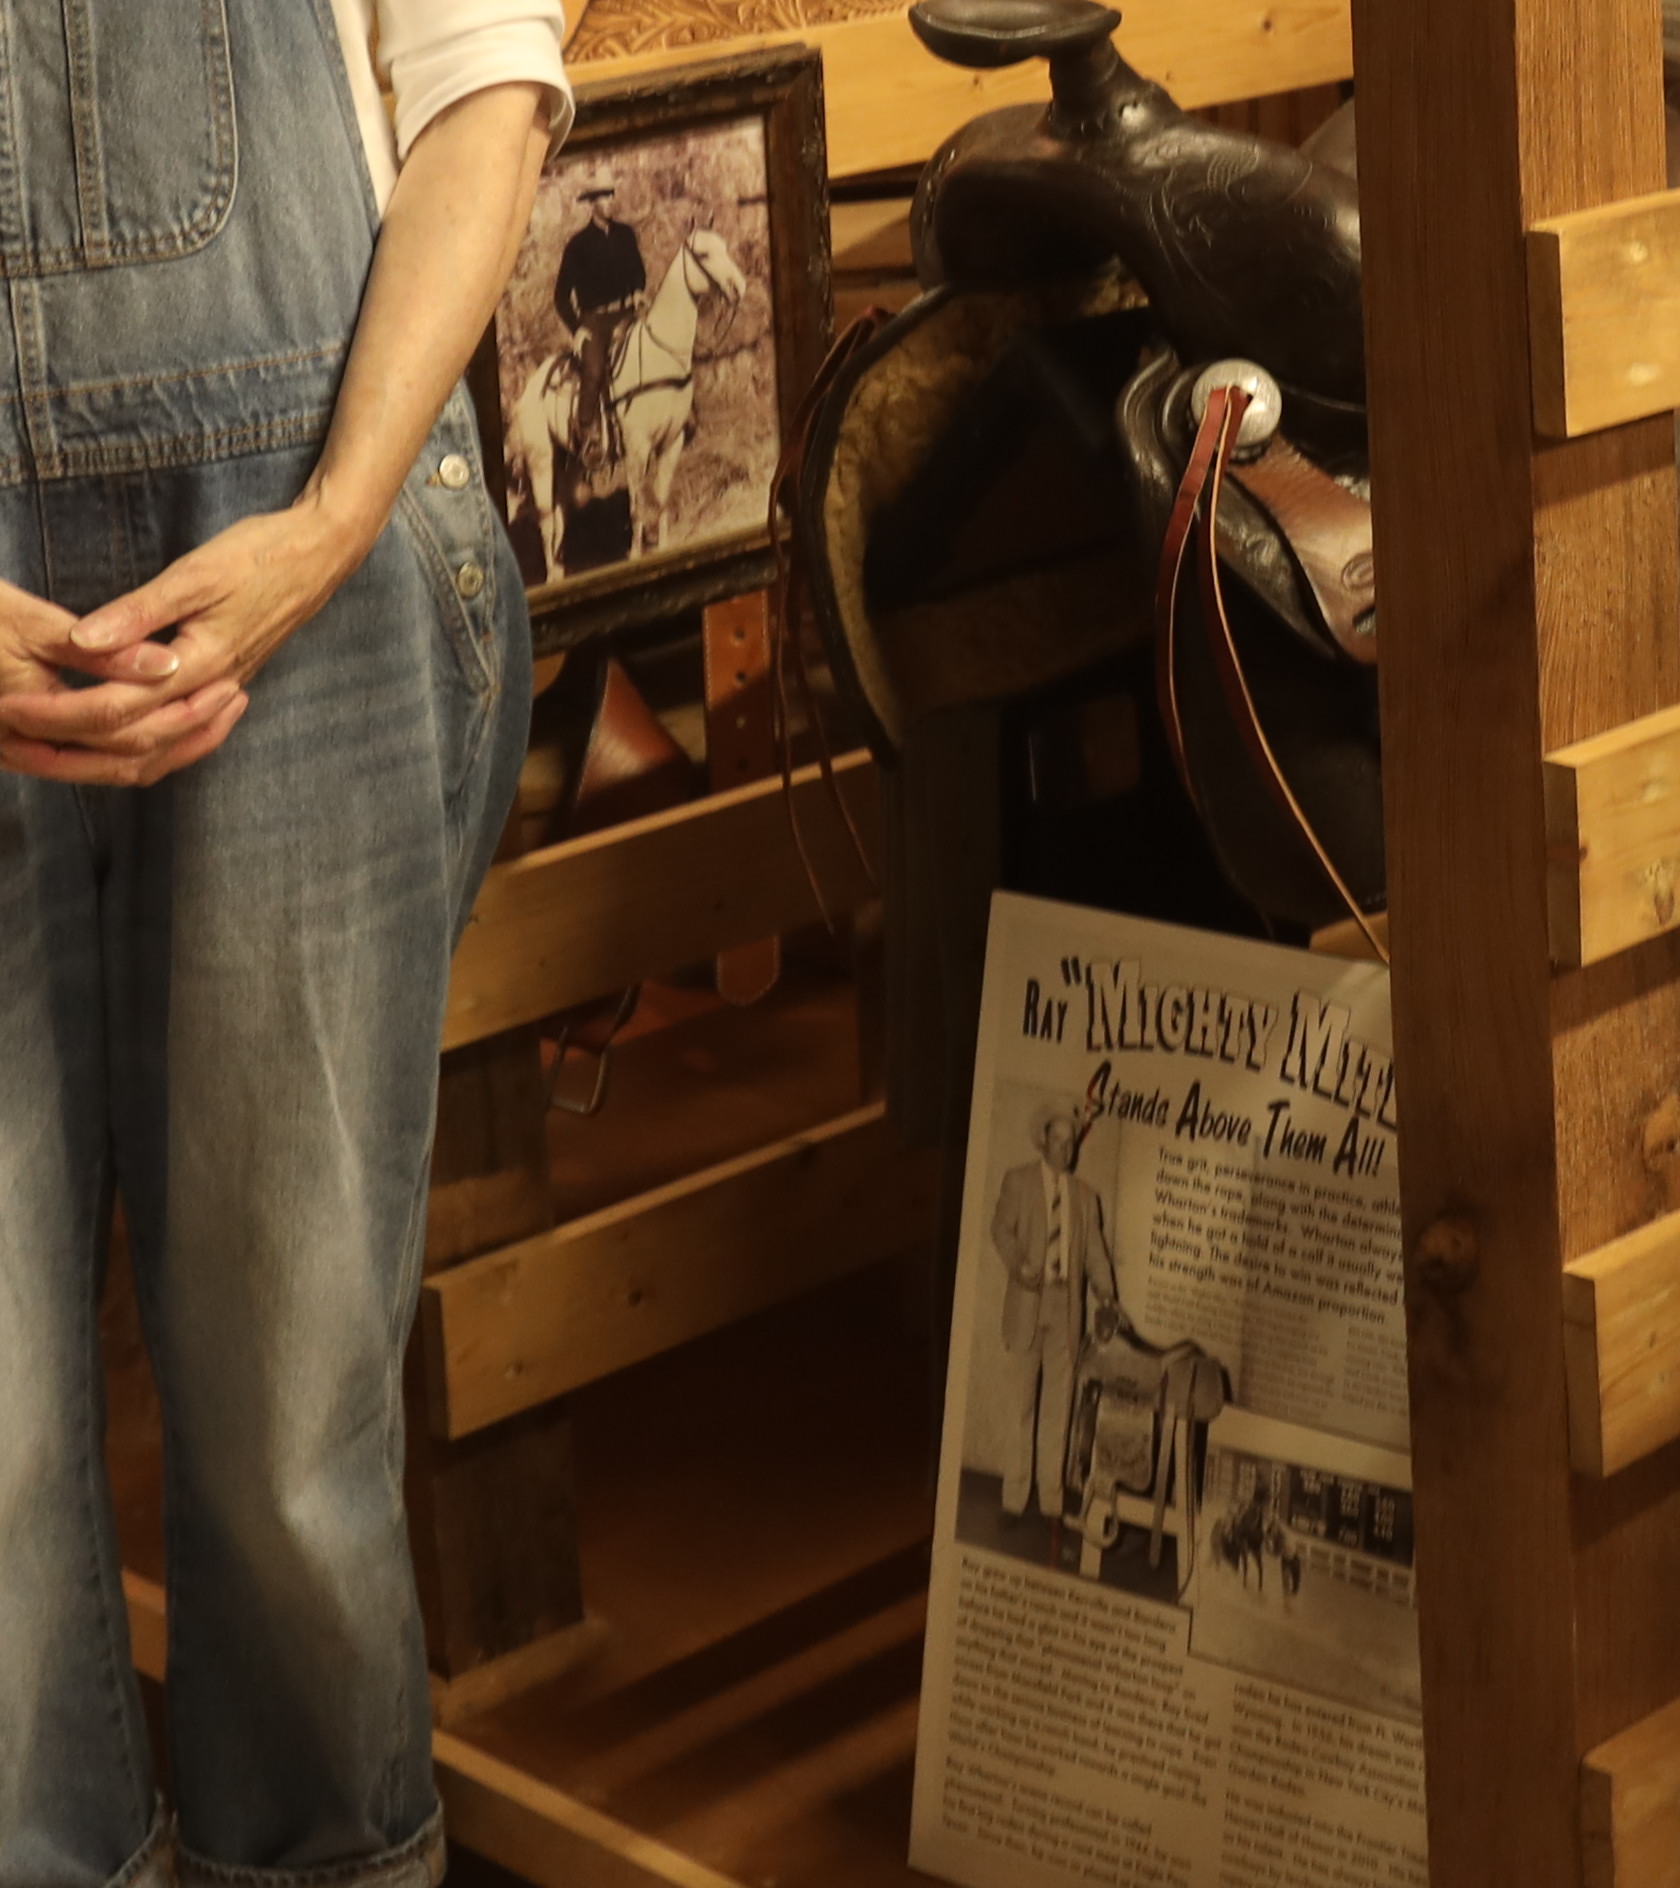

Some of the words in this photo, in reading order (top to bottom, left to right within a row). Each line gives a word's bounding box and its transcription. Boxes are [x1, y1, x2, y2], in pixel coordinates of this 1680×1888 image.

[1023, 977, 1068, 1044] RAY
[1070, 1060, 1170, 1174] Stands
[1175, 1079, 1252, 1146] Above
[1263, 1098, 1328, 1164] Them
[1332, 1115, 1387, 1178] All!
